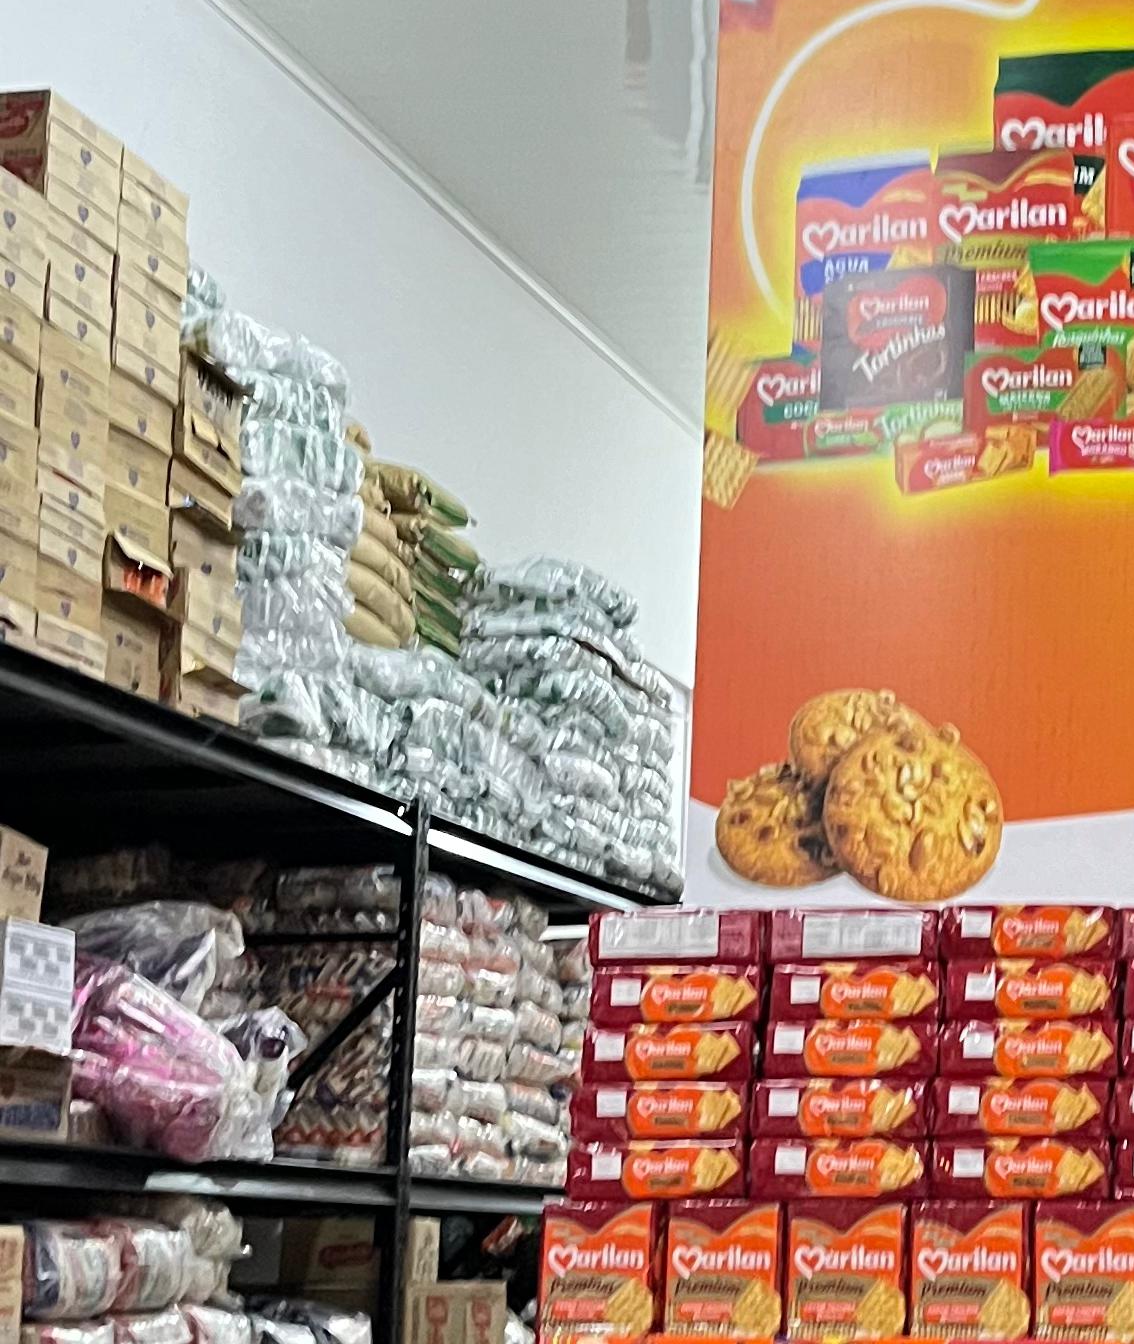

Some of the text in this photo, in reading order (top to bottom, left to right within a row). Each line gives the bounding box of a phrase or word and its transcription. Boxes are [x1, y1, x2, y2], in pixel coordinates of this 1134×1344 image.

[1001, 112, 1106, 151] Maril
[802, 213, 928, 262] Marilan
[938, 197, 1067, 245] Marilan
[757, 369, 821, 406] Maril
[982, 363, 1073, 399] Marilan
[547, 1243, 644, 1278] Marilan
[672, 1244, 771, 1280] Marilan
[794, 1244, 895, 1279] Marilan
[917, 1246, 1017, 1281] Marilan
